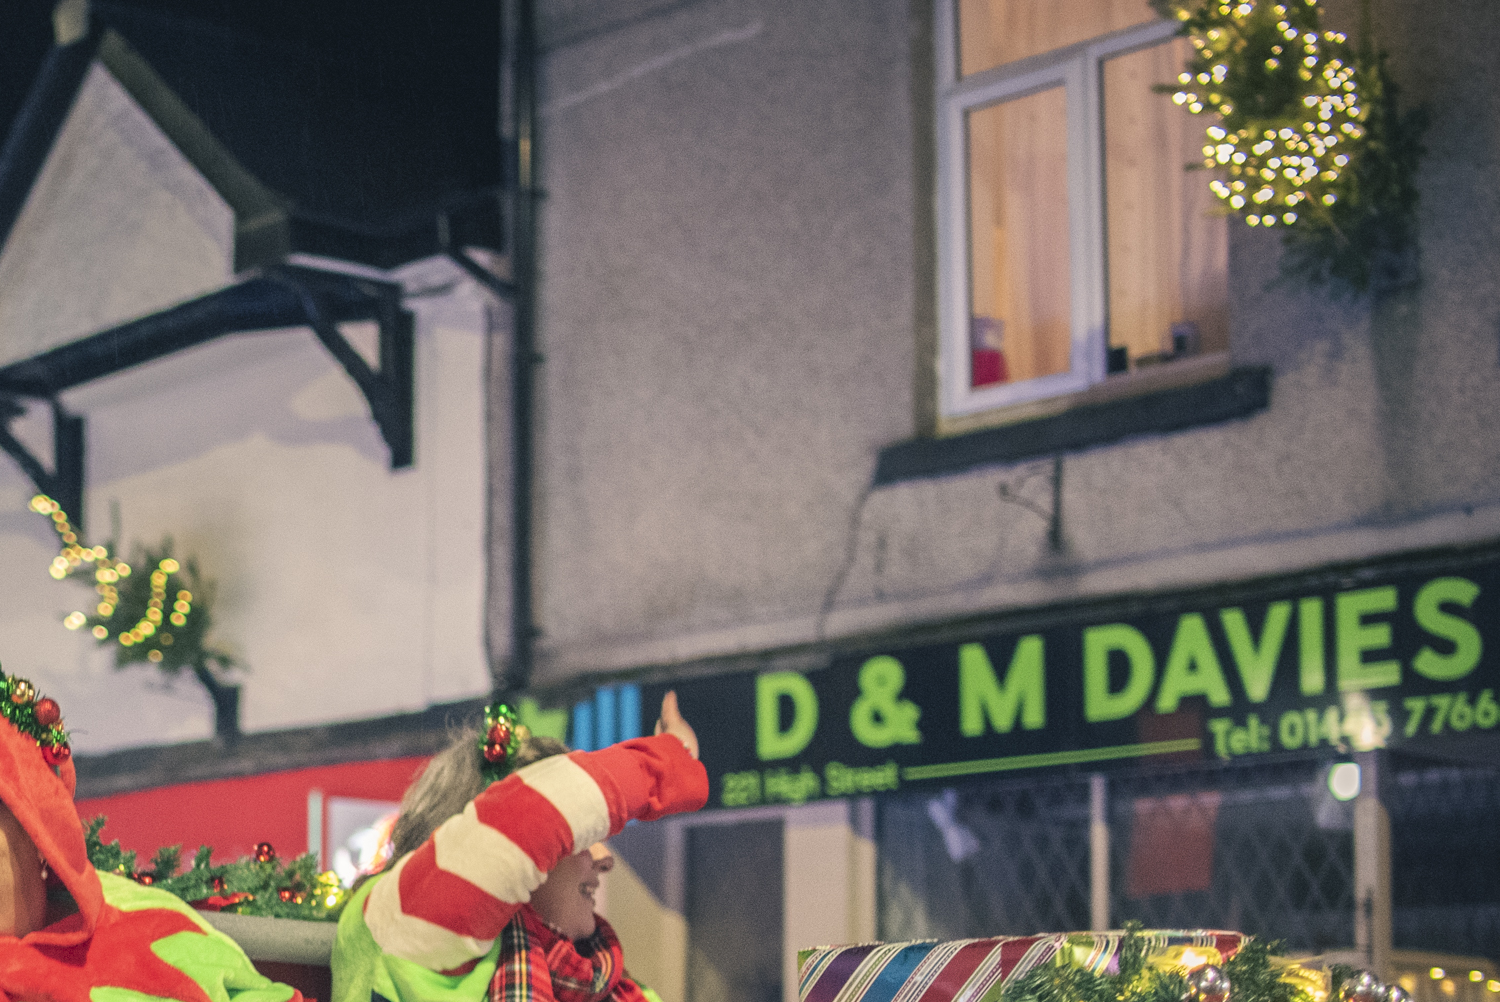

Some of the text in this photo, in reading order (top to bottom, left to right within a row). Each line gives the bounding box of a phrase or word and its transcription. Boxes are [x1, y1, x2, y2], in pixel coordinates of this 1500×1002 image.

[756, 576, 1483, 761] D & M DAVIES
[1208, 713, 1270, 760] Tel:
[824, 760, 898, 796] Street
